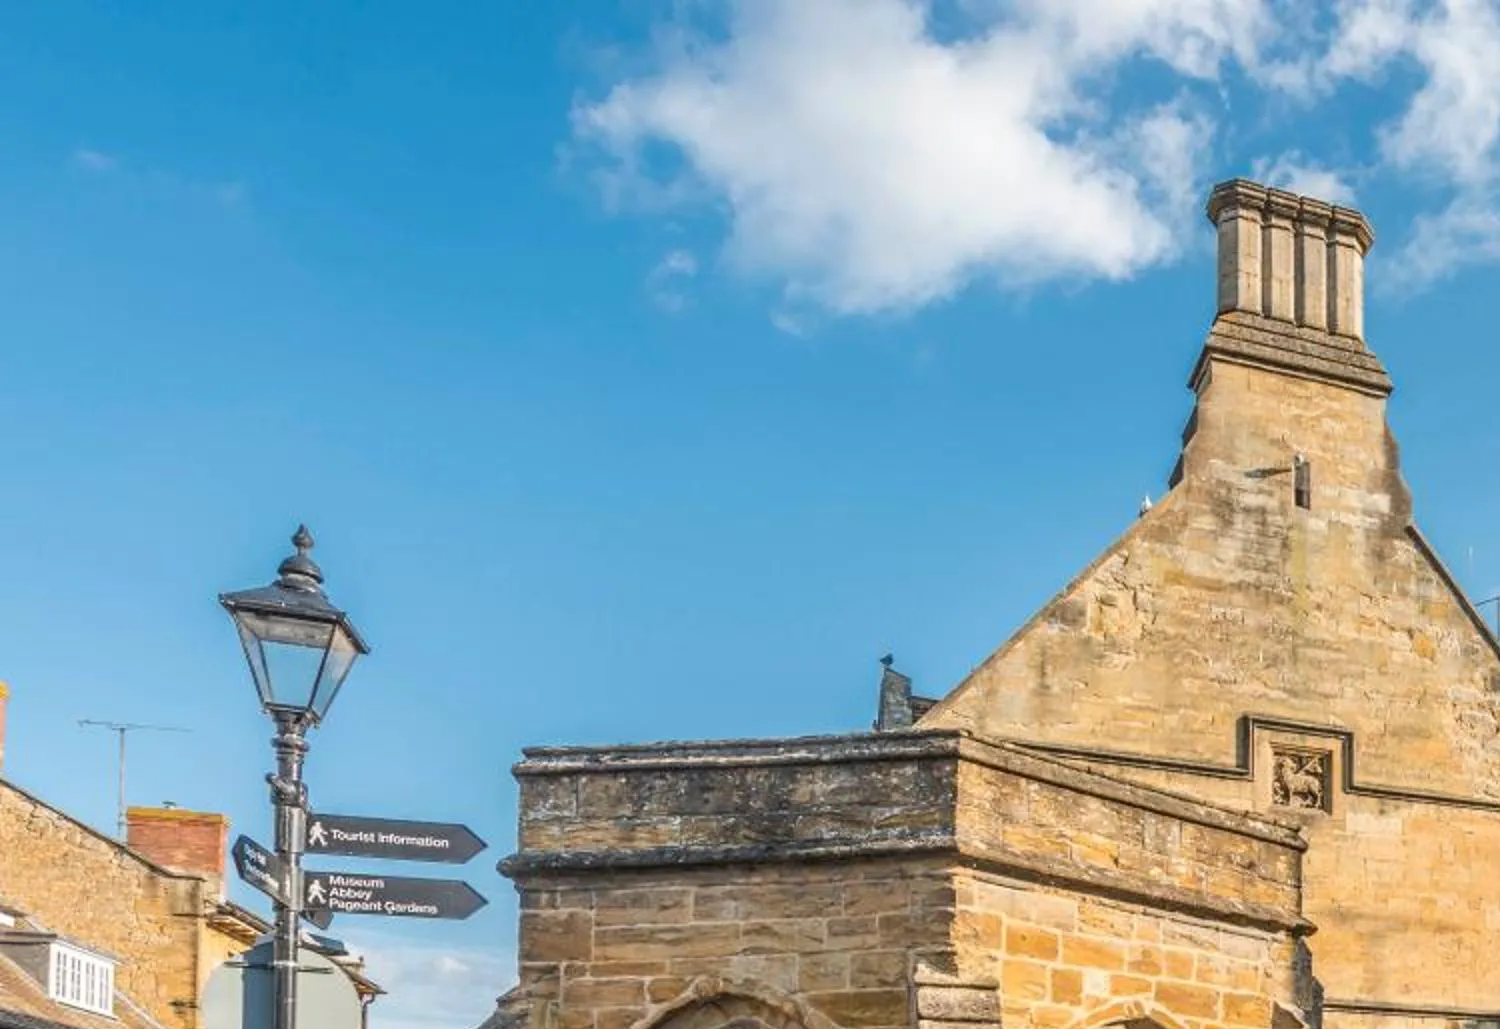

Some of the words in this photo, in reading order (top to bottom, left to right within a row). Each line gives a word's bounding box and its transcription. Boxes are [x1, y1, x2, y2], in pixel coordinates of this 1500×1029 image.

[331, 829, 375, 843] Tourist
[378, 832, 449, 848] Information
[329, 874, 385, 889] Museum
[329, 887, 373, 900] Abbey
[329, 898, 382, 912] Pageant
[383, 901, 439, 915] Gardens
